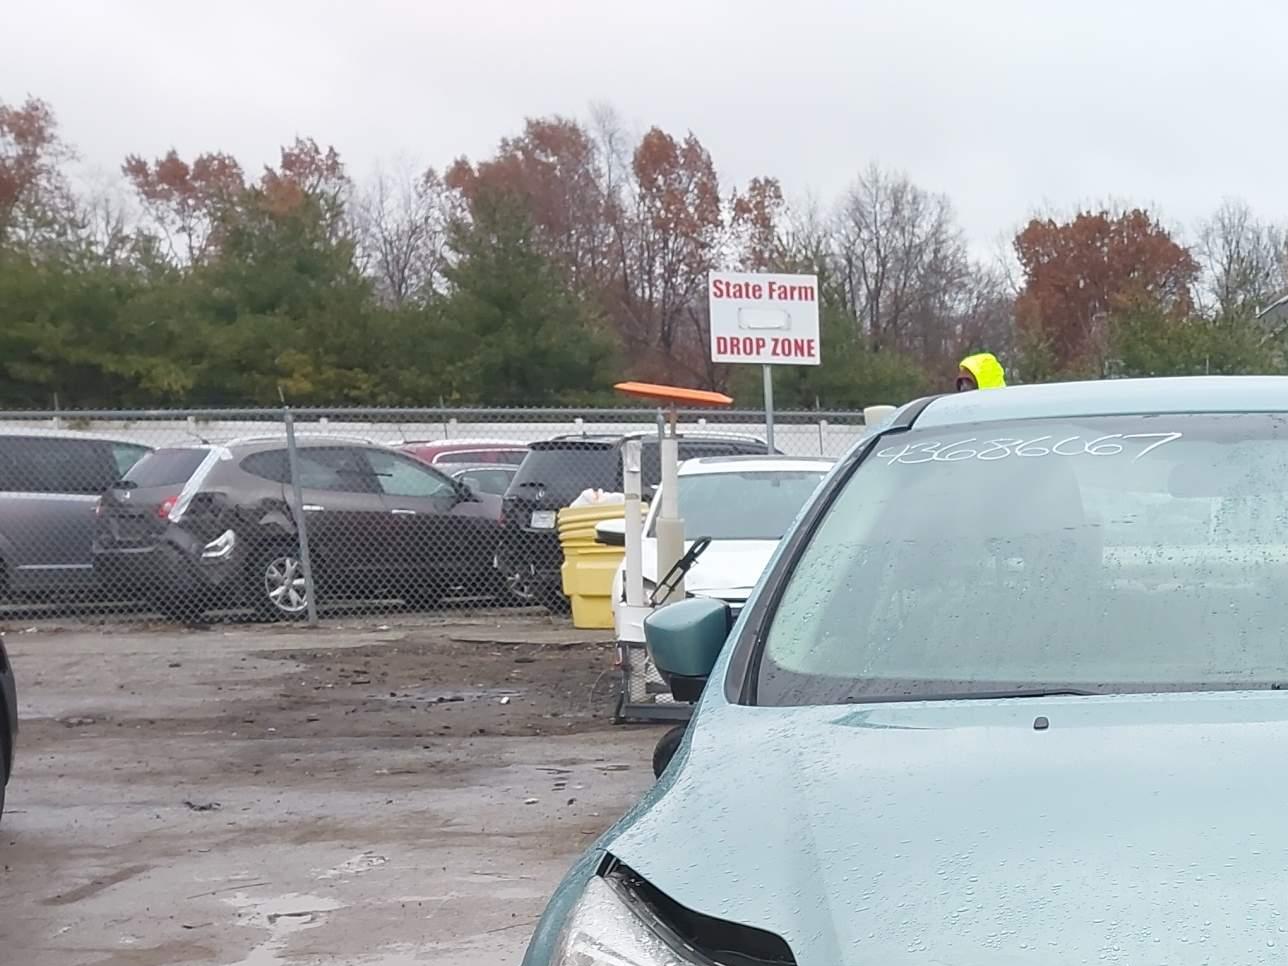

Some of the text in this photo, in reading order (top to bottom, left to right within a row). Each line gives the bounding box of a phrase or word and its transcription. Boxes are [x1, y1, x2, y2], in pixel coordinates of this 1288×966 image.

[713, 279, 815, 301] State Farm
[716, 336, 815, 357] DROP ZONE
[876, 431, 1182, 465] 43686067
